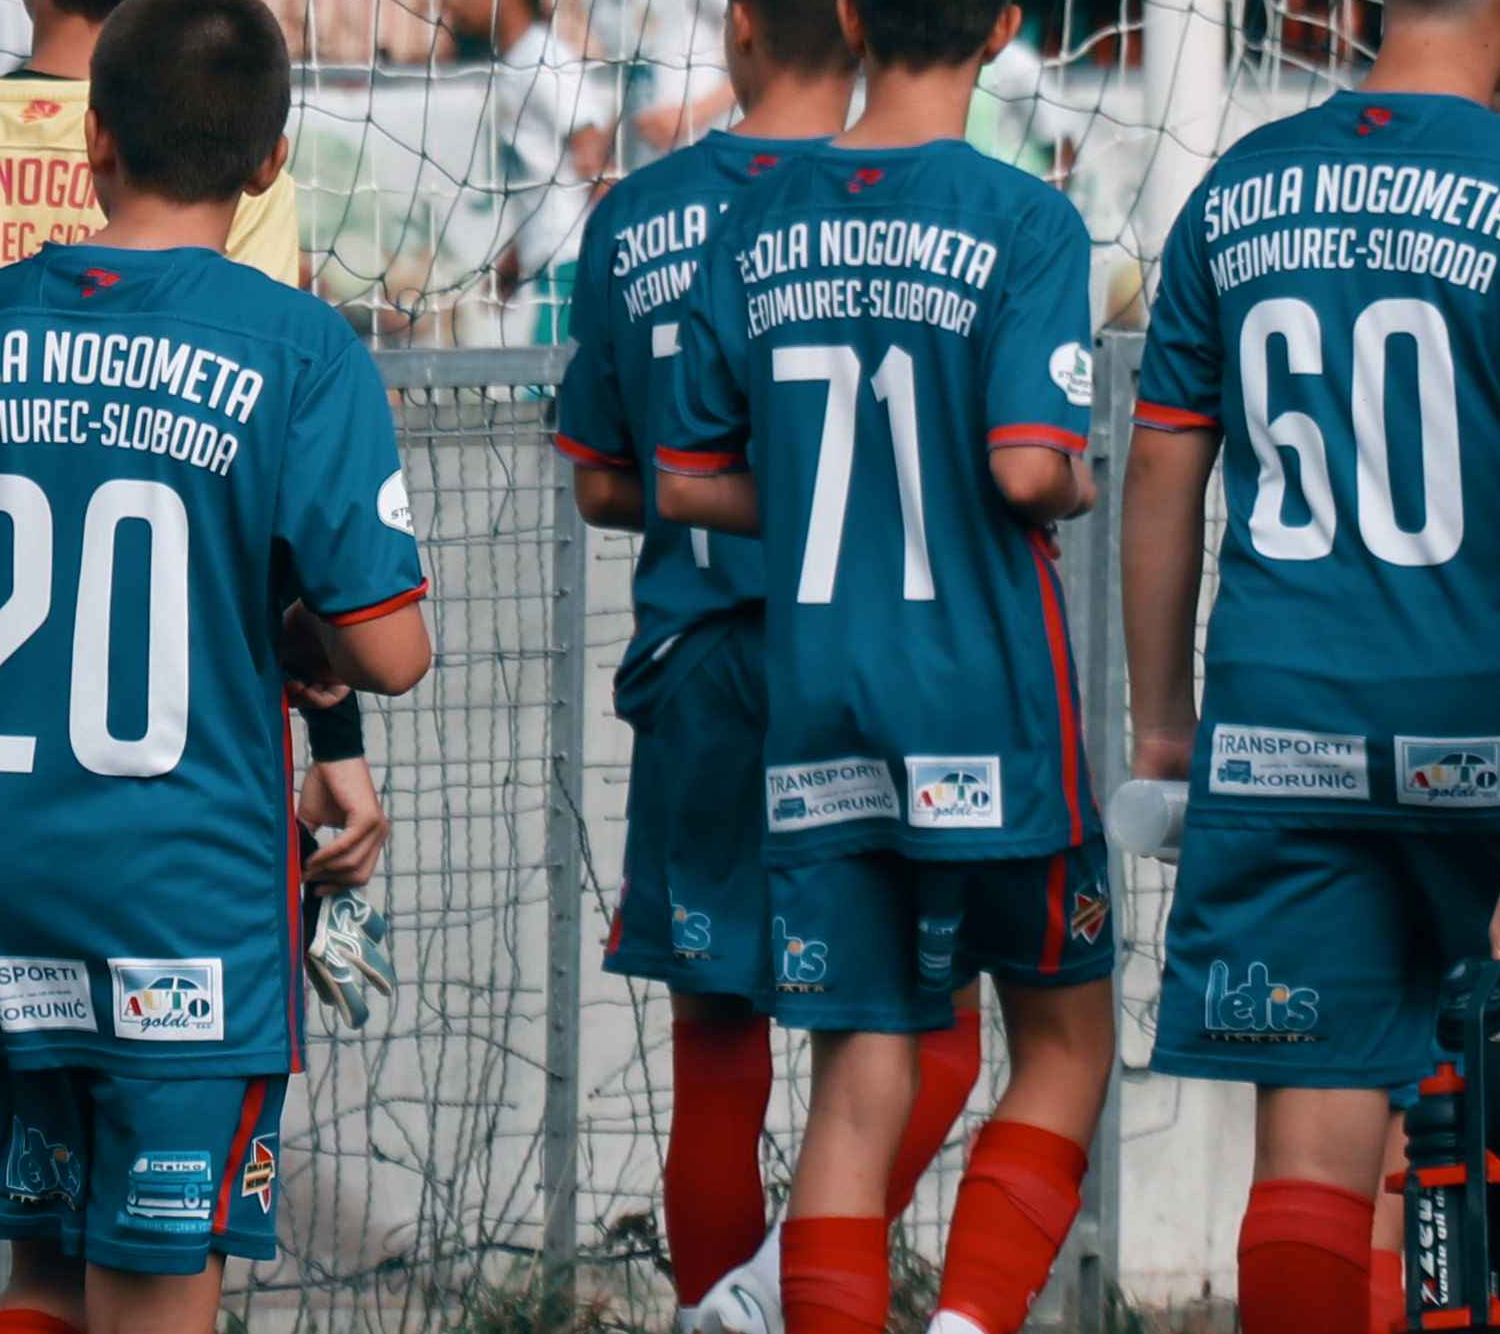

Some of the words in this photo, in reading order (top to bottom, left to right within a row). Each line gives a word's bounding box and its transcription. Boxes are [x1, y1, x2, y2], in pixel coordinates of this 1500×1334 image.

[1205, 168, 1303, 242] ŠKOLA
[820, 220, 997, 289] NOGOMETA
[43, 330, 263, 424] NOGOMETA
[1239, 298, 1464, 566] 60
[771, 345, 935, 603] 71
[1219, 734, 1352, 756] TRANSPORTI
[0, 1000, 88, 1022] ORUNIĆ
[123, 990, 211, 1018] AUTO
